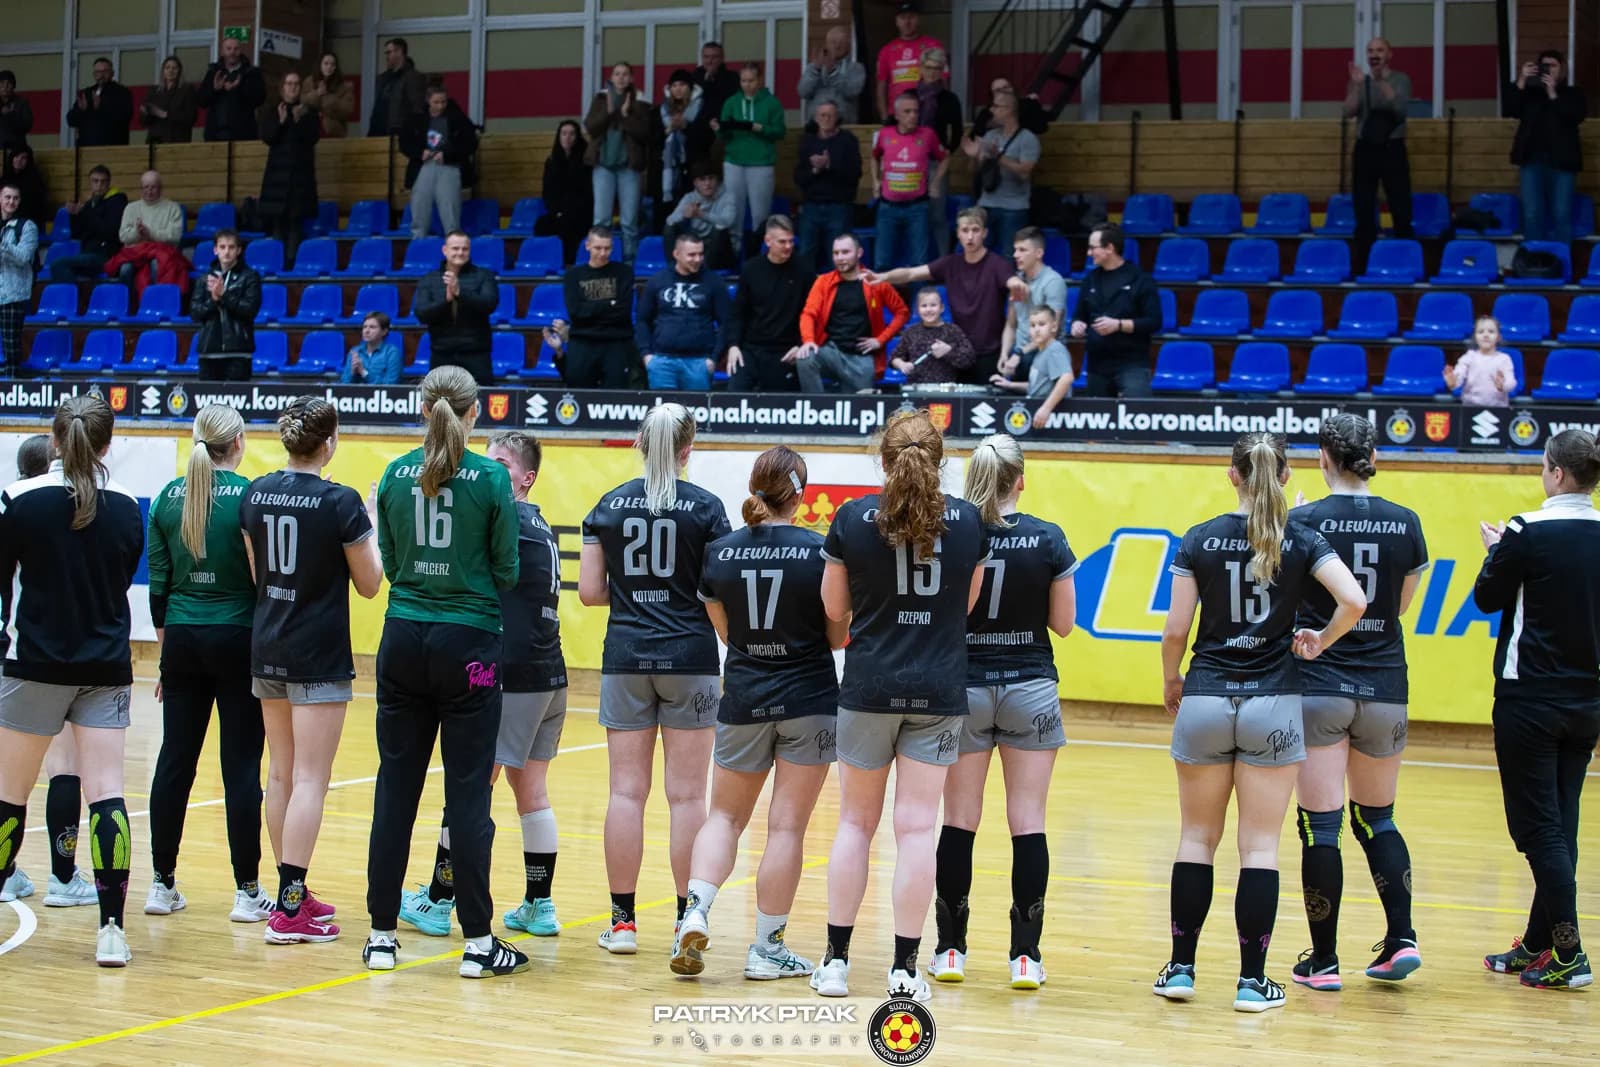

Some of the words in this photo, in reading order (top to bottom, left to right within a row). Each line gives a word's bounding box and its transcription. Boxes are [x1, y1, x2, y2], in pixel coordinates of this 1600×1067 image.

[261, 493, 322, 509] LEWIATAN
[411, 487, 453, 549] 16
[1338, 519, 1407, 535] LEWIATAN
[263, 514, 298, 575] 10
[623, 517, 677, 578] 20
[735, 547, 810, 561] LEWIATAN
[895, 535, 941, 596] 15
[988, 535, 1040, 550] IATAN
[1353, 542, 1379, 604] 5
[741, 569, 783, 630] 17
[898, 611, 931, 625] RZEPKA
[1225, 560, 1271, 624] 13
